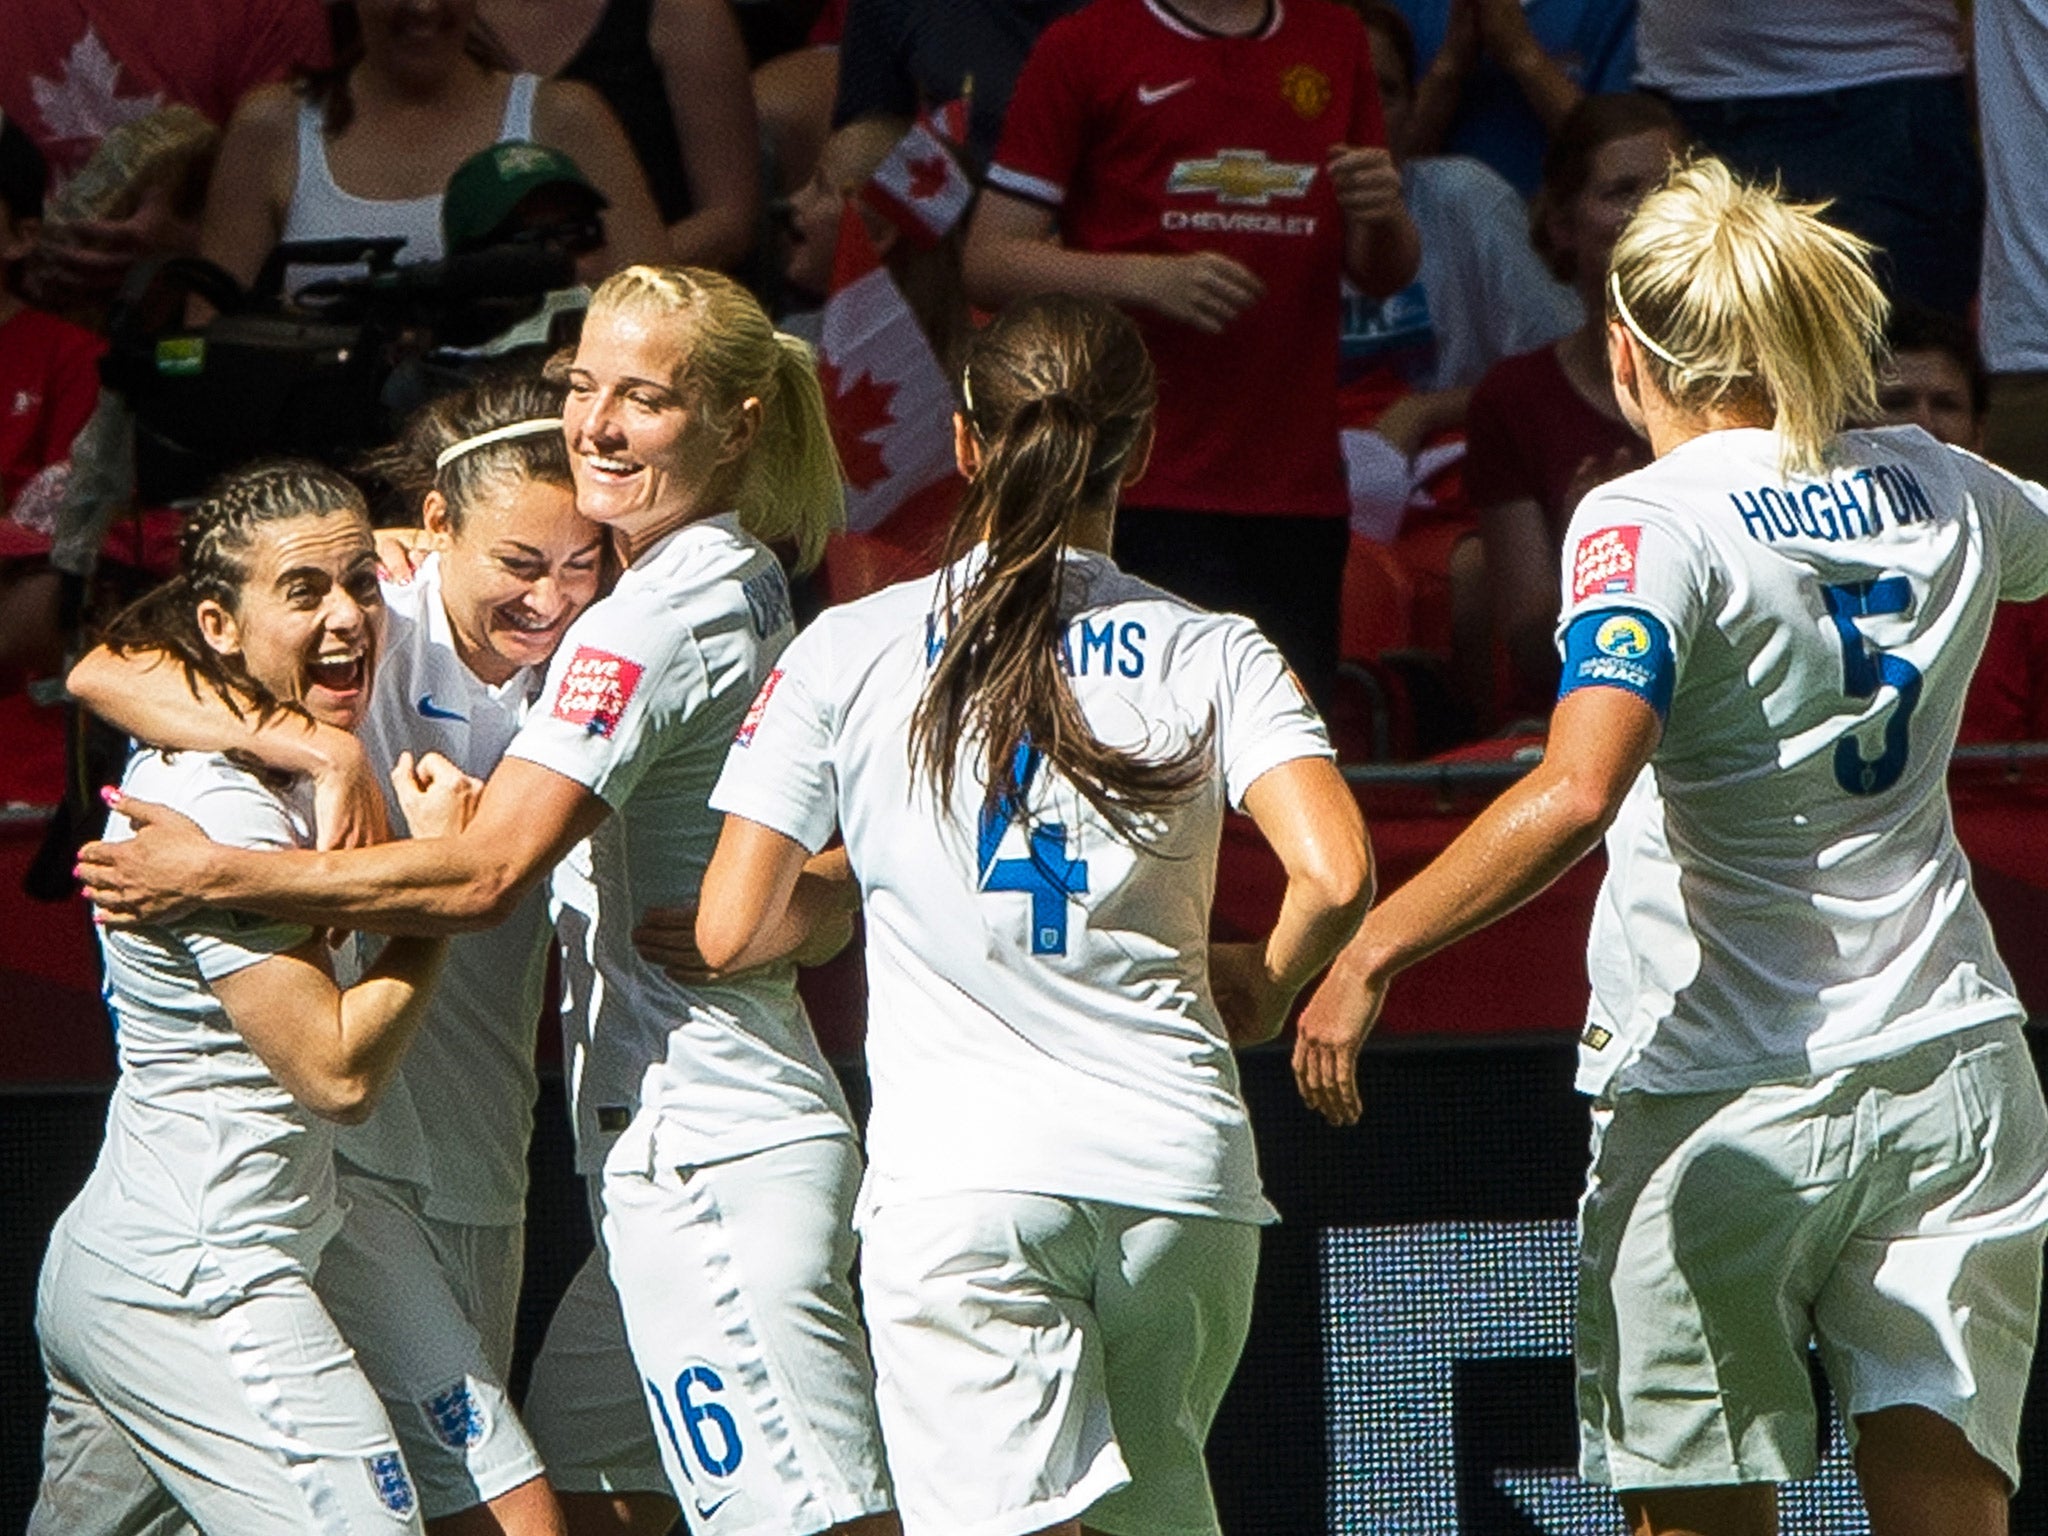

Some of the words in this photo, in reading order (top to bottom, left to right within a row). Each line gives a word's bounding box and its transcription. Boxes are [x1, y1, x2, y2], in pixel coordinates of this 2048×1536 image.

[1162, 209, 1316, 236] CHEVROLET
[1729, 463, 1936, 542] HOUGHTON
[570, 658, 620, 677] LIVE
[1592, 666, 1649, 688] PEACE
[566, 673, 623, 699] YOUR
[1819, 574, 1924, 796] 5
[558, 693, 625, 717] GOALS
[977, 727, 1089, 956] 4
[645, 1365, 743, 1486] 16
